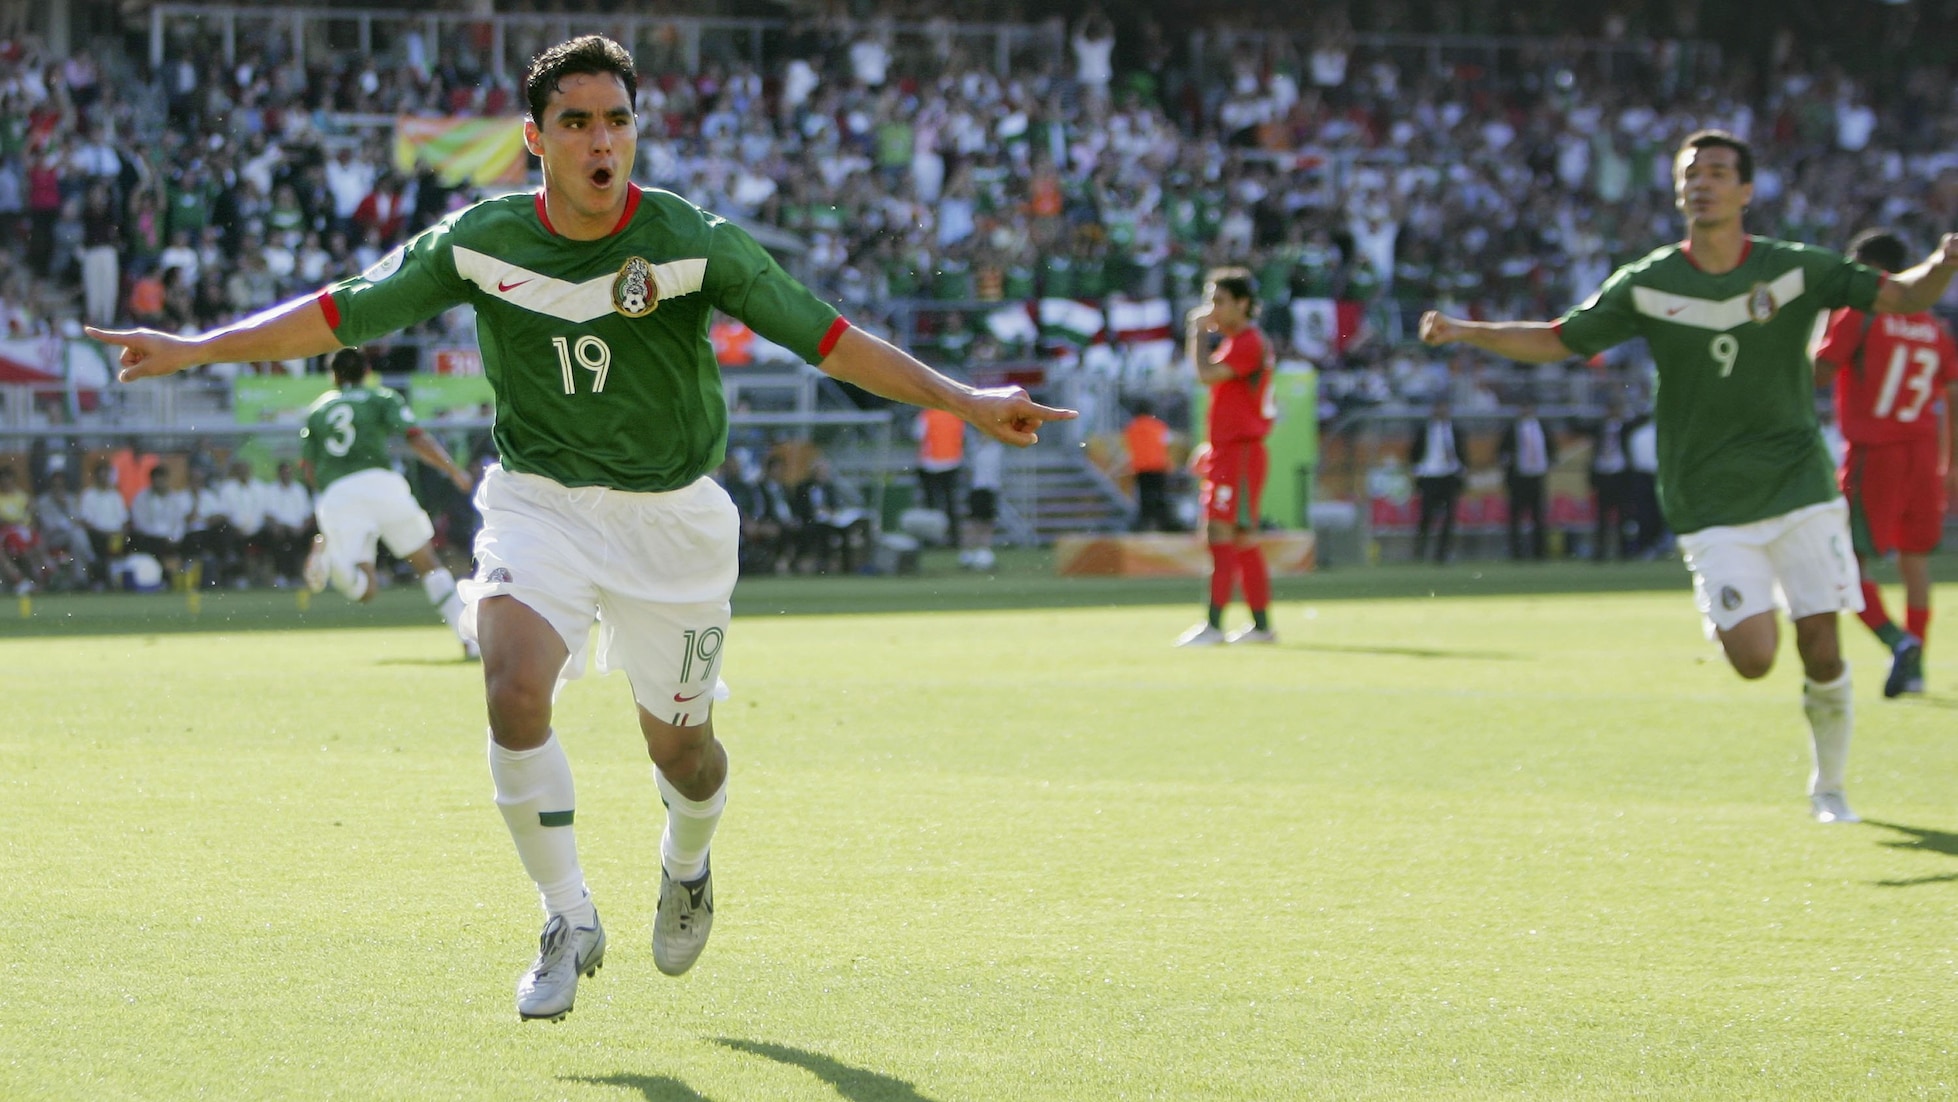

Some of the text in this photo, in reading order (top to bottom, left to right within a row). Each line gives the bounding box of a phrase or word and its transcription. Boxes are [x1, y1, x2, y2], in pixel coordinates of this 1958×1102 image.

[552, 335, 611, 394] 19
[1710, 334, 1739, 378] 9
[1875, 344, 1940, 422] 13
[325, 403, 355, 457] 3
[680, 626, 724, 683] 19
